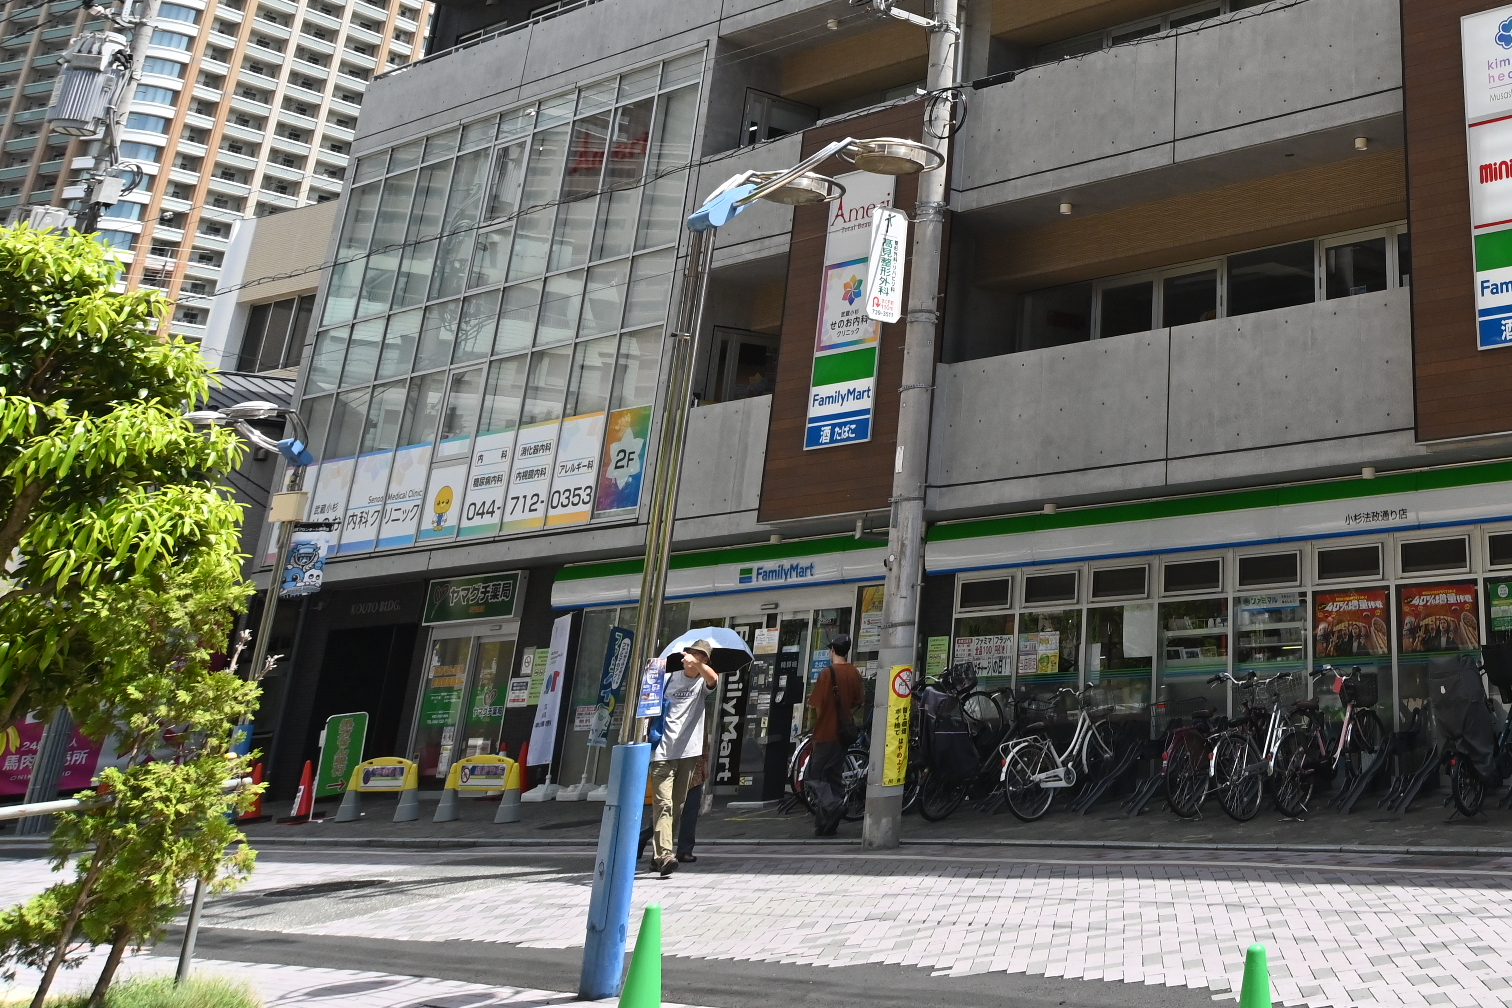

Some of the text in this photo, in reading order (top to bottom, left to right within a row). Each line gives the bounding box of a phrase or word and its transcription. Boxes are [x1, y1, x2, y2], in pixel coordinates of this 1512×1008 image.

[830, 192, 891, 226] Amei
[830, 315, 869, 331] せのお内科
[836, 327, 860, 338] クリニック
[812, 386, 872, 408] FamilyMart
[819, 423, 857, 444] 酒 たばこ
[519, 442, 552, 458] 消化器内科
[558, 459, 594, 474] アレルギー科
[613, 449, 636, 470] 2F
[472, 473, 504, 488] 糖尿病内科
[515, 467, 547, 481] 内視鏡内科
[313, 502, 339, 515] 武蔵小杉
[1344, 508, 1408, 526] 小杉法政通り店
[756, 562, 814, 582] FamilyMart
[449, 580, 514, 606] ヤマグチ薬局
[1250, 596, 1279, 605] ファミマル
[351, 601, 377, 614] KOUTO
